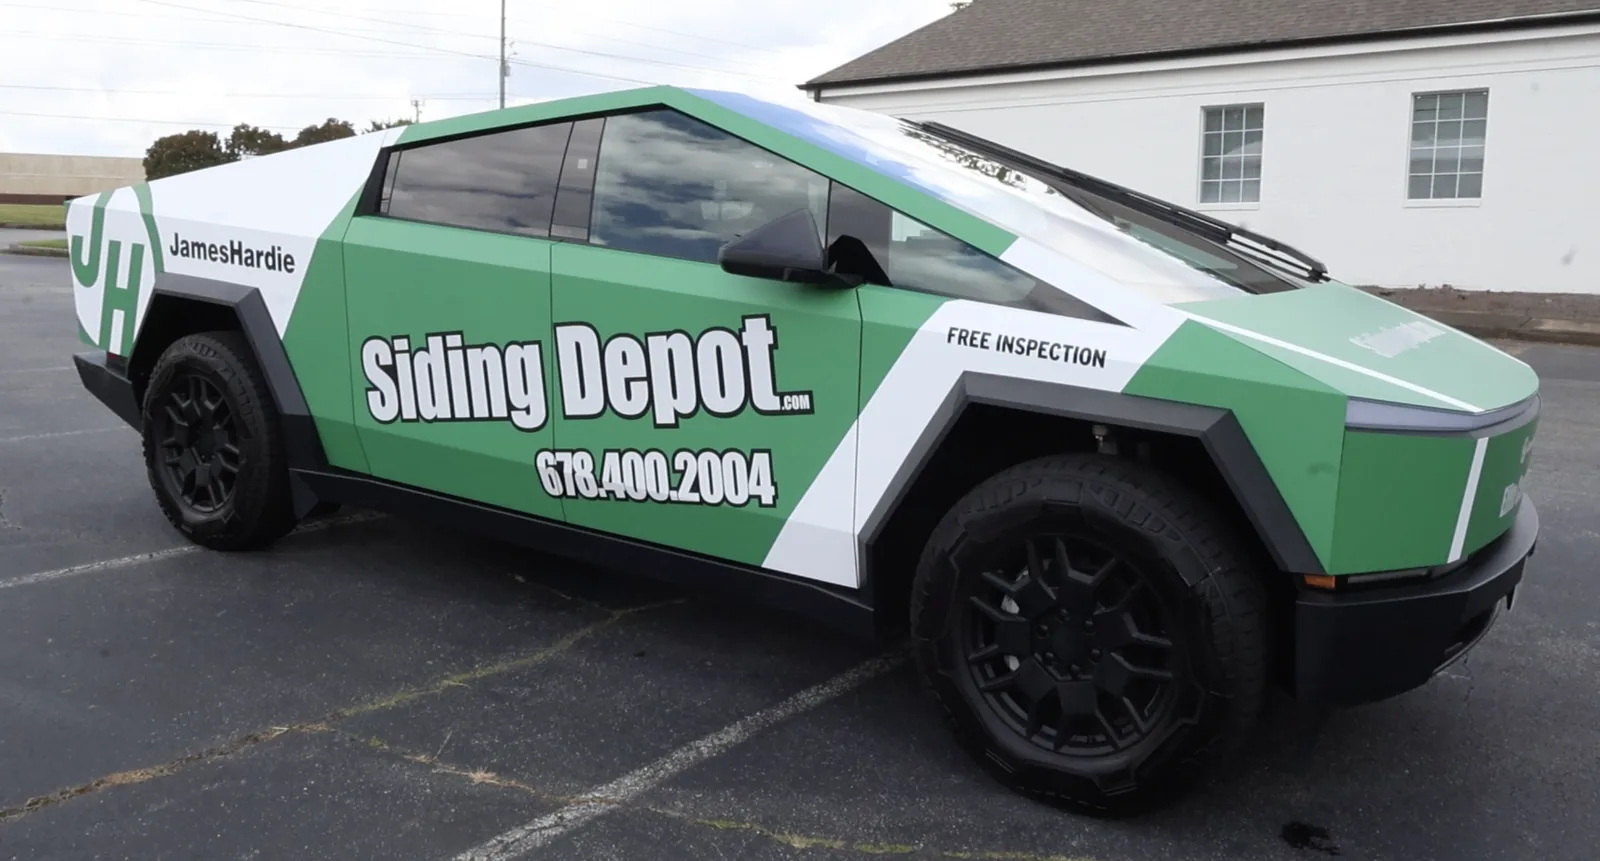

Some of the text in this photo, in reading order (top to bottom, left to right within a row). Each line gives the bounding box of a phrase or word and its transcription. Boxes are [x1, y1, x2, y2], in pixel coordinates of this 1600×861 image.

[170, 232, 295, 273] JamesHardie
[947, 327, 1107, 369] FREE INSPECTION
[362, 331, 547, 431] Siding
[535, 449, 777, 507] 678.400.2004
